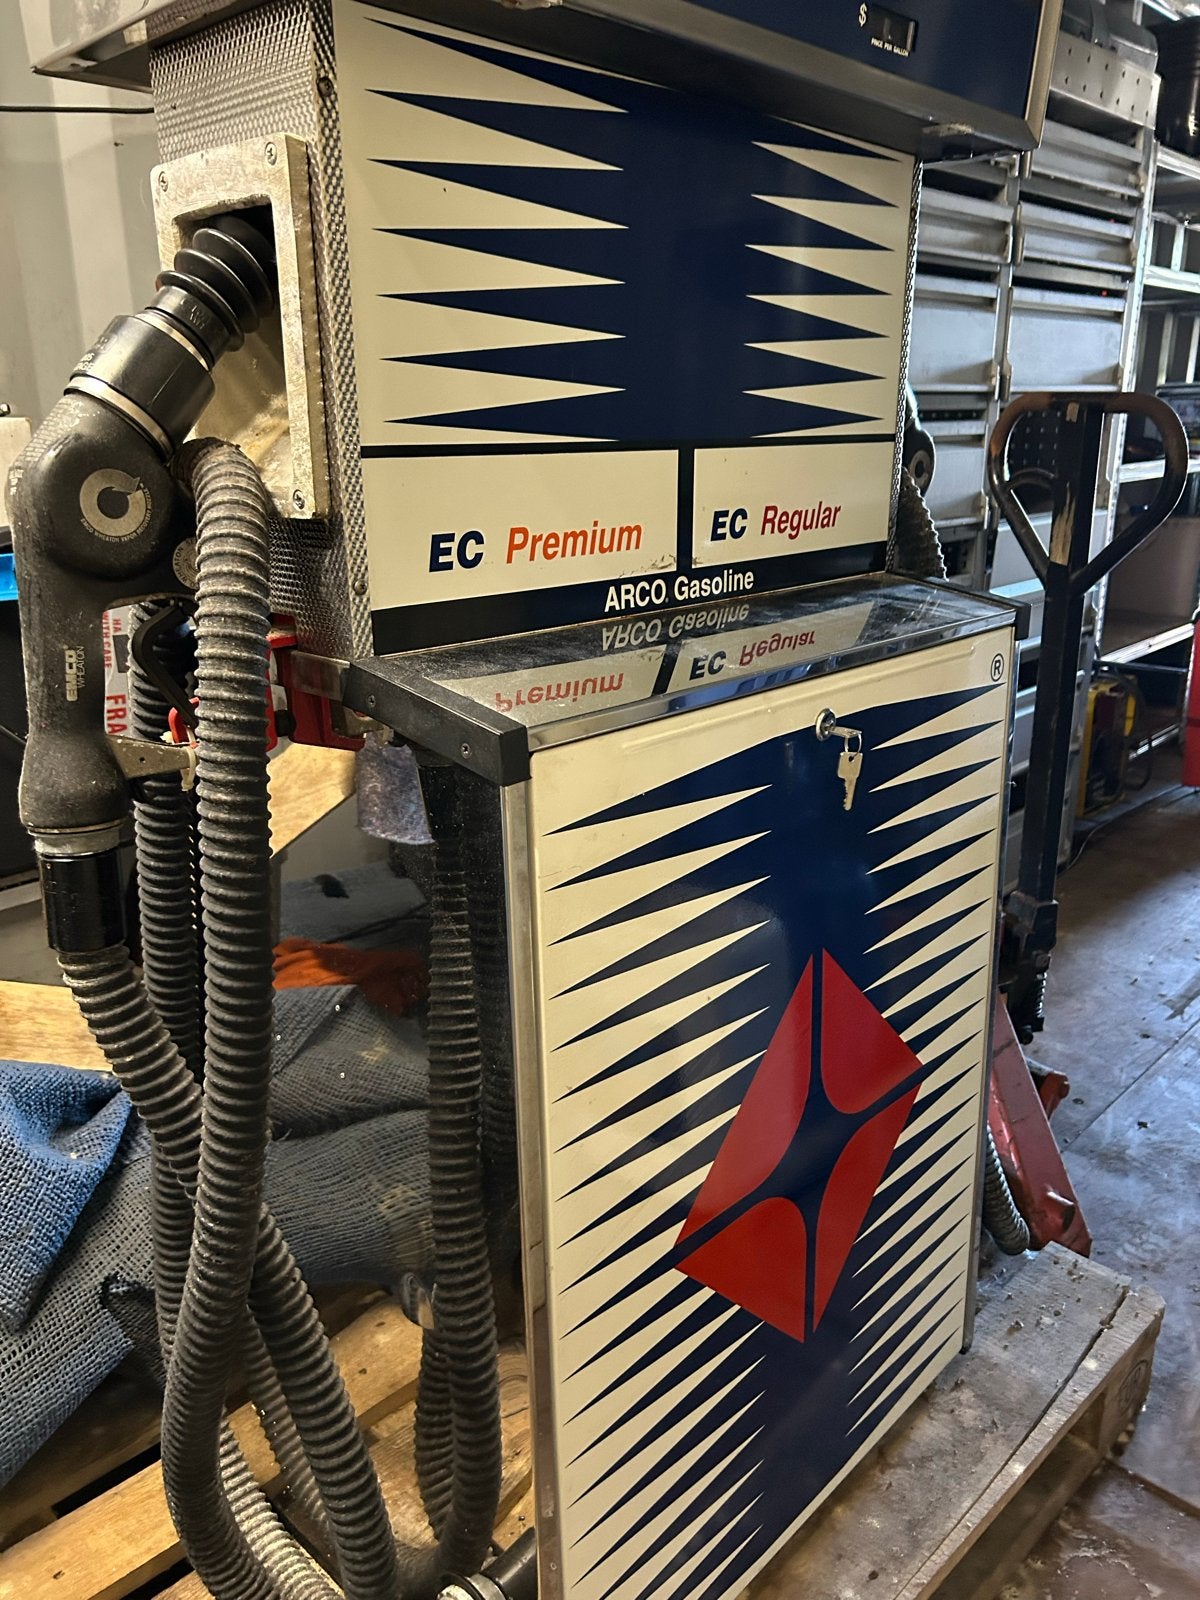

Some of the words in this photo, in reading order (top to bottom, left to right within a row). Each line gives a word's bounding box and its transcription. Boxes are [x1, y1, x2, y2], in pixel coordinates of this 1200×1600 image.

[858, 3, 868, 27] $
[710, 508, 748, 542] EC
[760, 501, 842, 540] Regular
[429, 530, 485, 572] EC
[506, 520, 643, 564] Premium
[604, 579, 667, 613] ARCO
[674, 570, 755, 601] Gasoline
